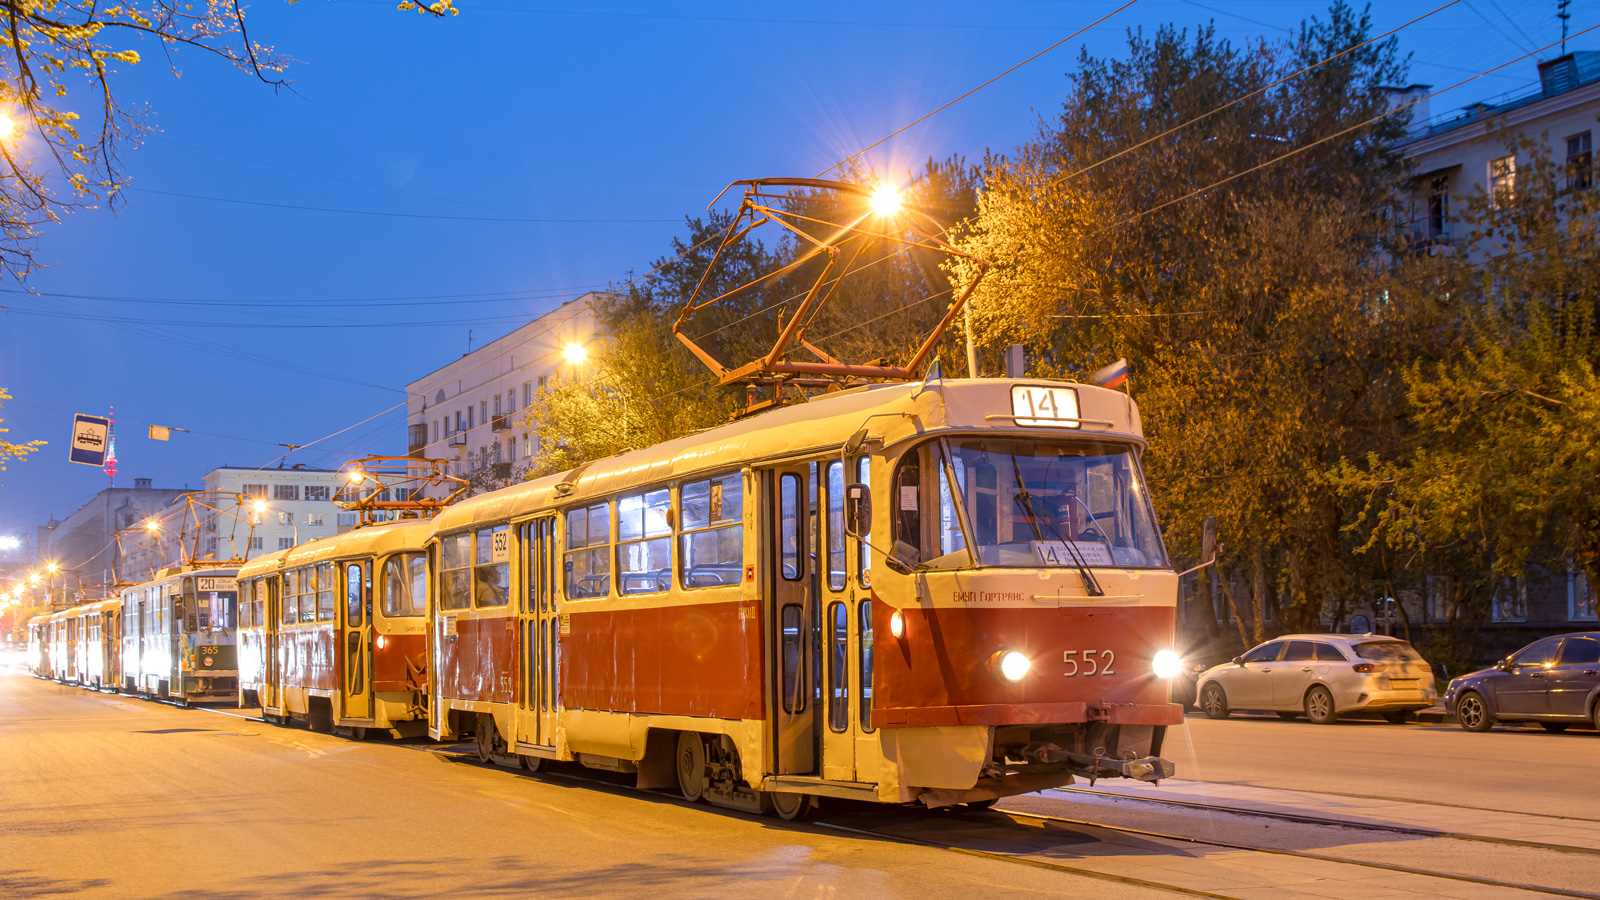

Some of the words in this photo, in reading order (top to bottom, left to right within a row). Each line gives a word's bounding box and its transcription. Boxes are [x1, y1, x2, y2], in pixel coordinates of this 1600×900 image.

[1022, 389, 1059, 422] 14
[495, 532, 507, 551] 552
[1037, 546, 1060, 565] 14
[201, 578, 215, 590] 20
[953, 591, 976, 602] ЕМУП
[201, 645, 219, 655] 365
[1063, 649, 1116, 677] 552
